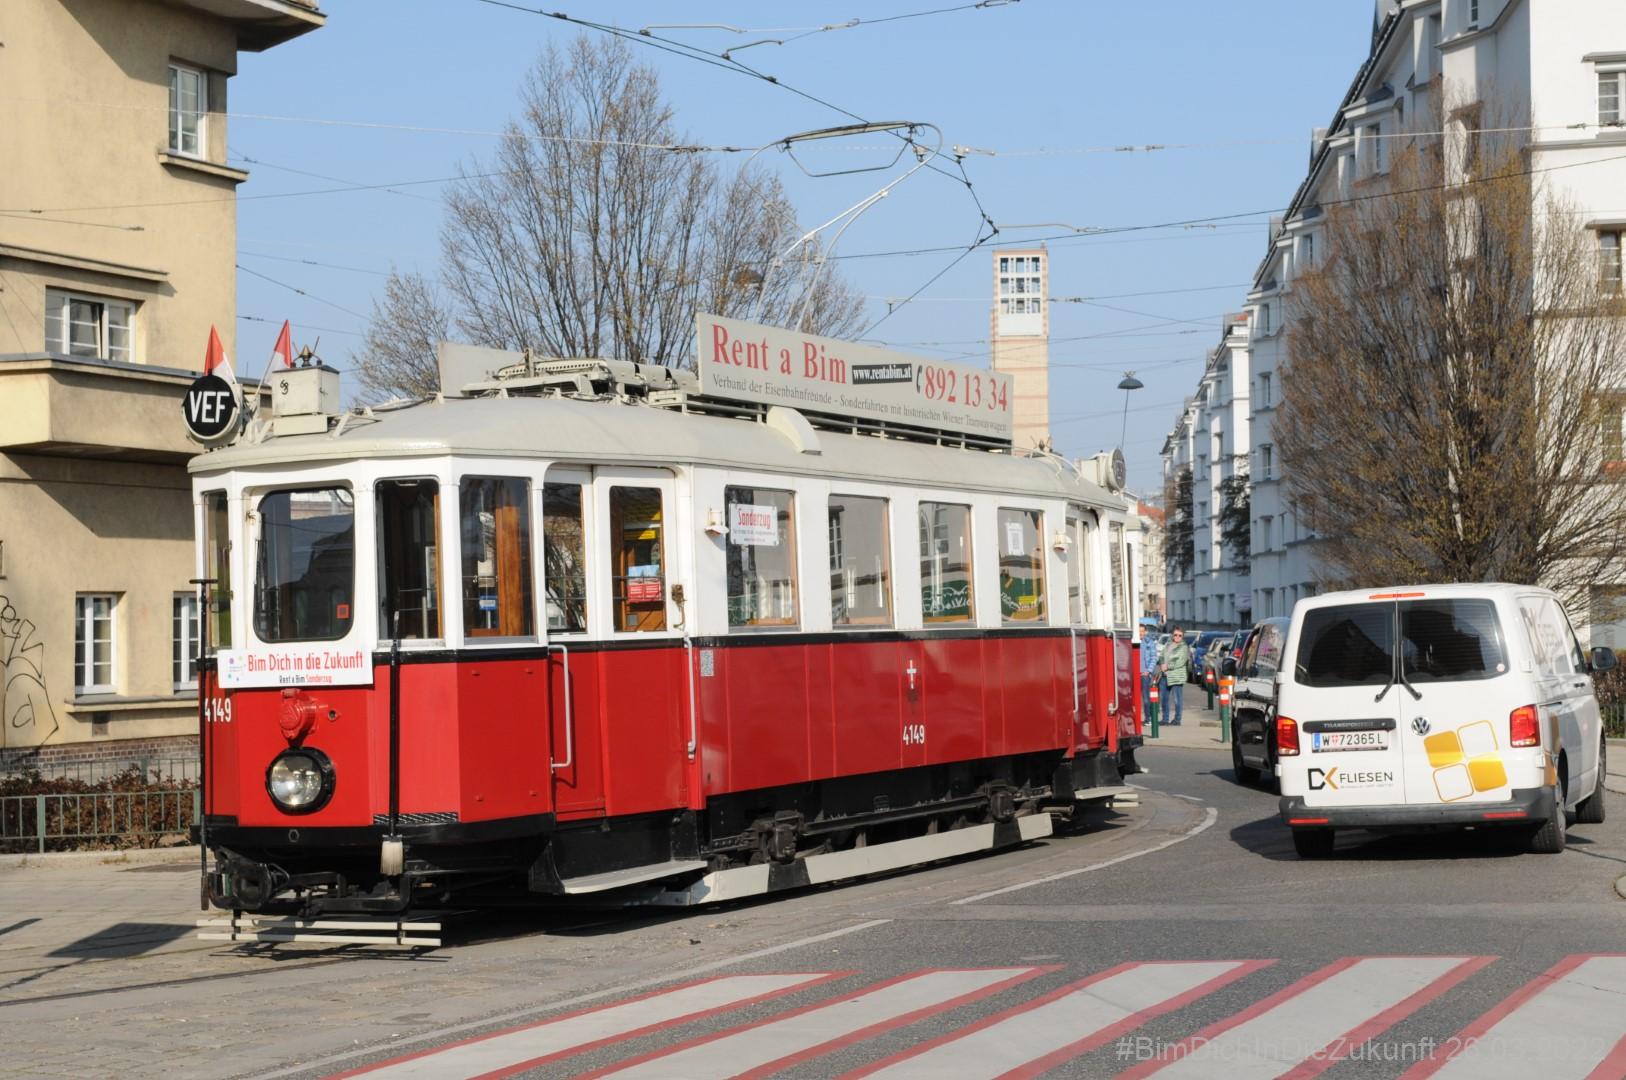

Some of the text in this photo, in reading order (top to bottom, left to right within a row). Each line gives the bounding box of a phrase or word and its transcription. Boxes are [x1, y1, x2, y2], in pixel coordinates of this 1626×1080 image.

[712, 324, 847, 385] Rent a Bim
[852, 364, 911, 380] www.rentabim.at
[713, 373, 747, 391] Verband
[749, 380, 763, 394] der
[765, 382, 832, 405] Eisenbahnfreunde
[840, 394, 888, 413] Sonderfahrten
[925, 365, 1008, 412] 892 13 34
[190, 390, 230, 423] VEF
[738, 510, 771, 529] Sonderzug
[248, 650, 363, 671] Bim Dich in die Zukunft
[204, 698, 232, 722] 4149
[902, 724, 925, 745] 4149
[1322, 735, 1330, 746] W
[1340, 772, 1393, 783] FLIESEN
